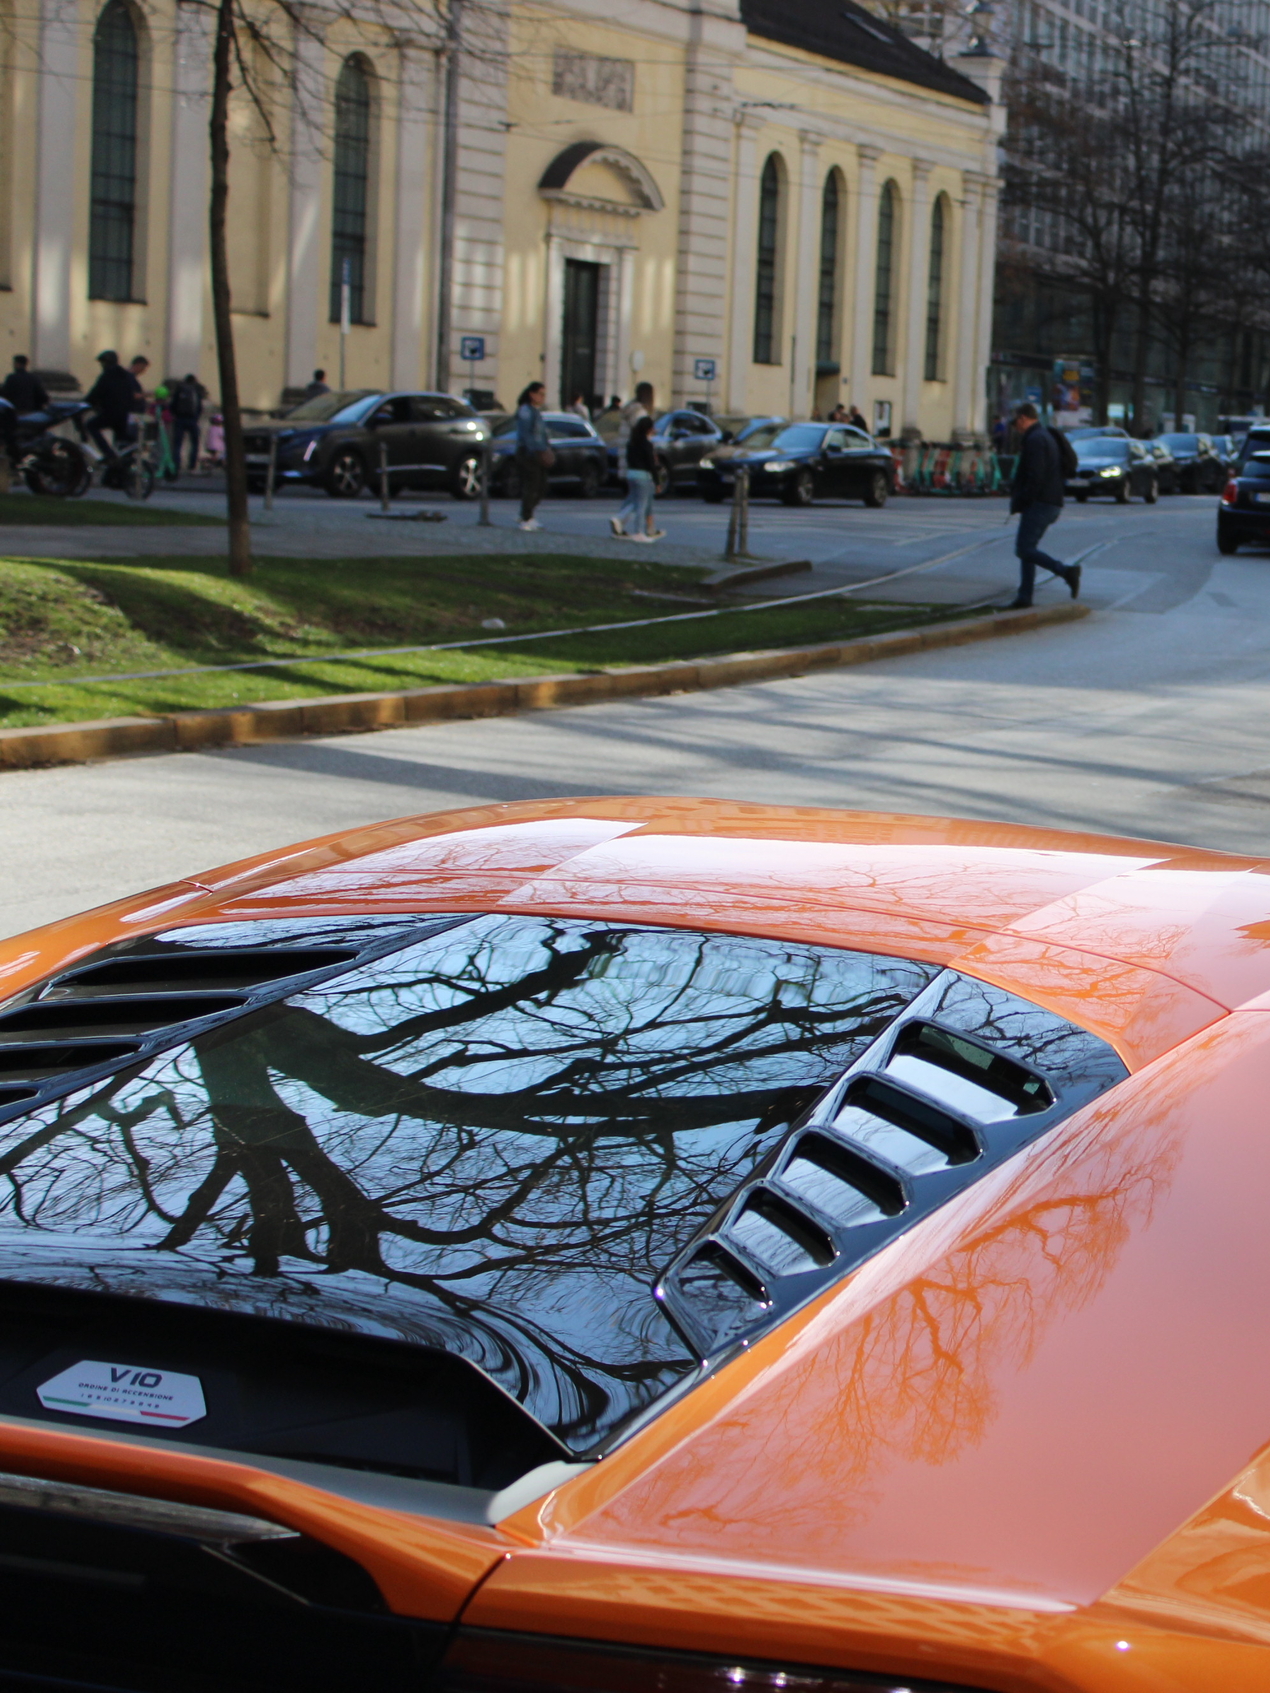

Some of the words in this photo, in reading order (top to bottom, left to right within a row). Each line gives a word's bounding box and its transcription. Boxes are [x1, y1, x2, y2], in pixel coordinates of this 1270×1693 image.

[110, 1367, 162, 1388] V10
[78, 1382, 109, 1391] ORDINE
[122, 1389, 174, 1401] ACCENSIONE
